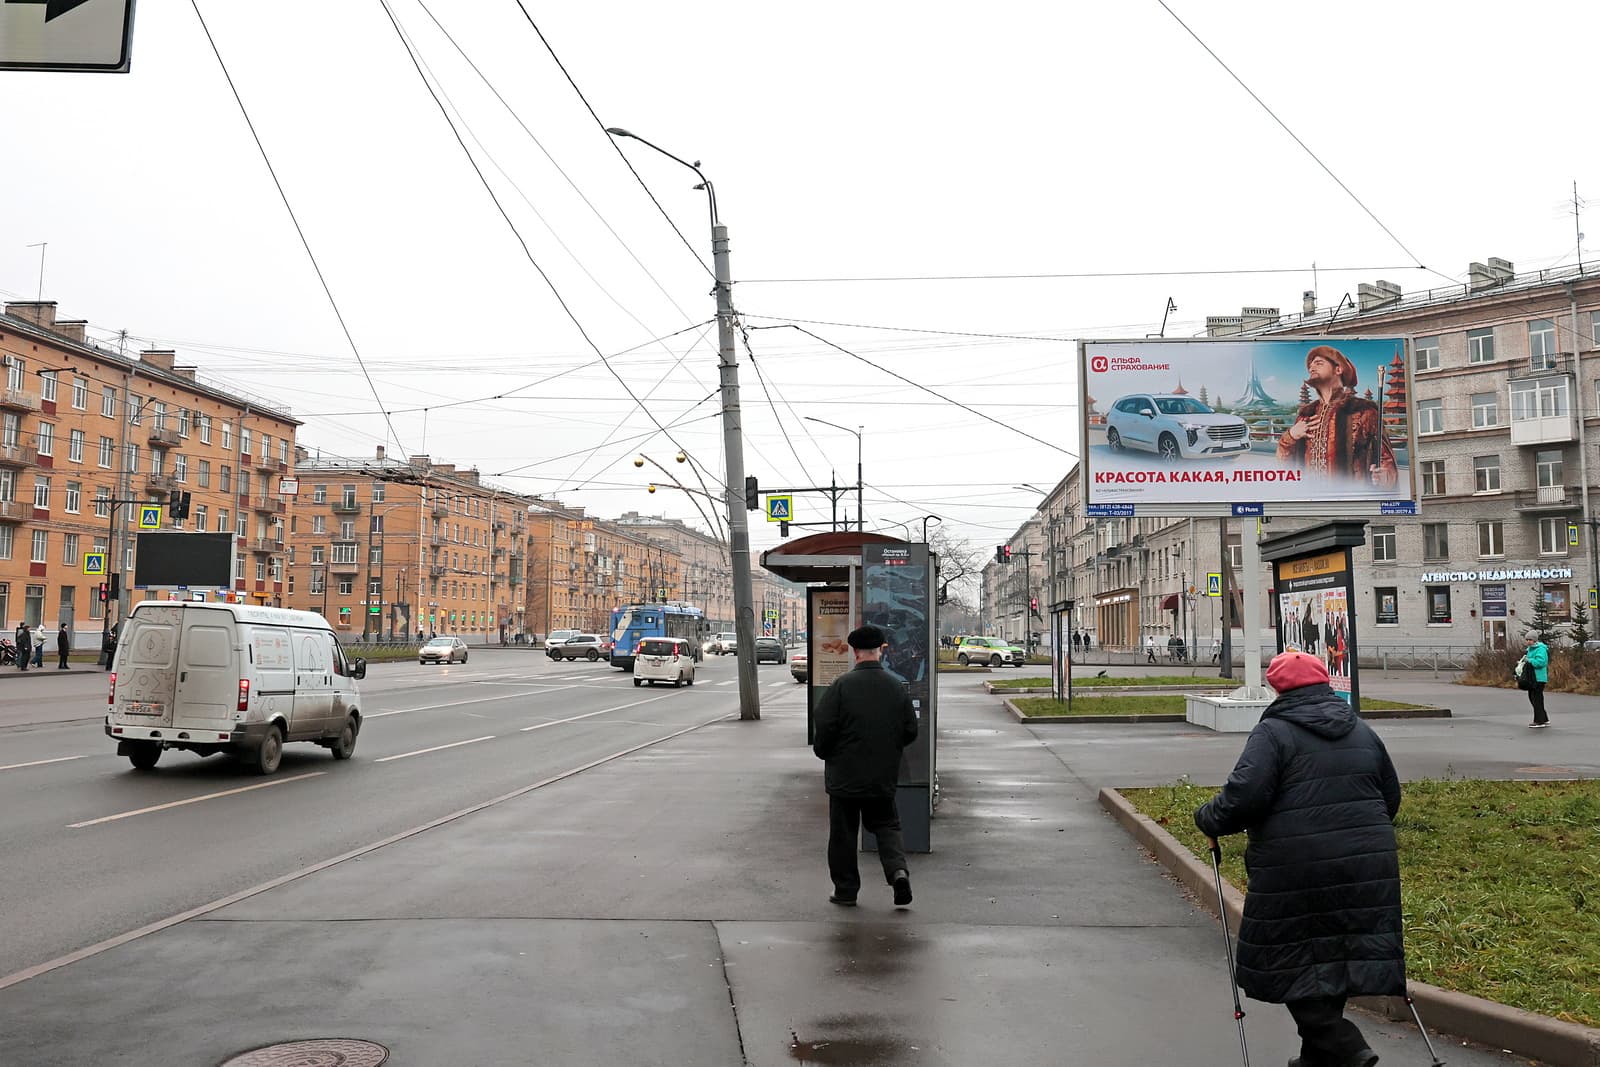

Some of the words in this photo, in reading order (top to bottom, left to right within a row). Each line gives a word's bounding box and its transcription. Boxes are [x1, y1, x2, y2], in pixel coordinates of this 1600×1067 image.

[1095, 471, 1167, 483] КРАСОТА
[1169, 471, 1230, 484] КАКАЯ,
[1232, 469, 1302, 482] ЛЕПОТА!
[1421, 571, 1477, 583] АГЕНТСТВО
[1479, 568, 1573, 581] НЕДВИЖИМОСТИ
[820, 606, 849, 614] удовол
